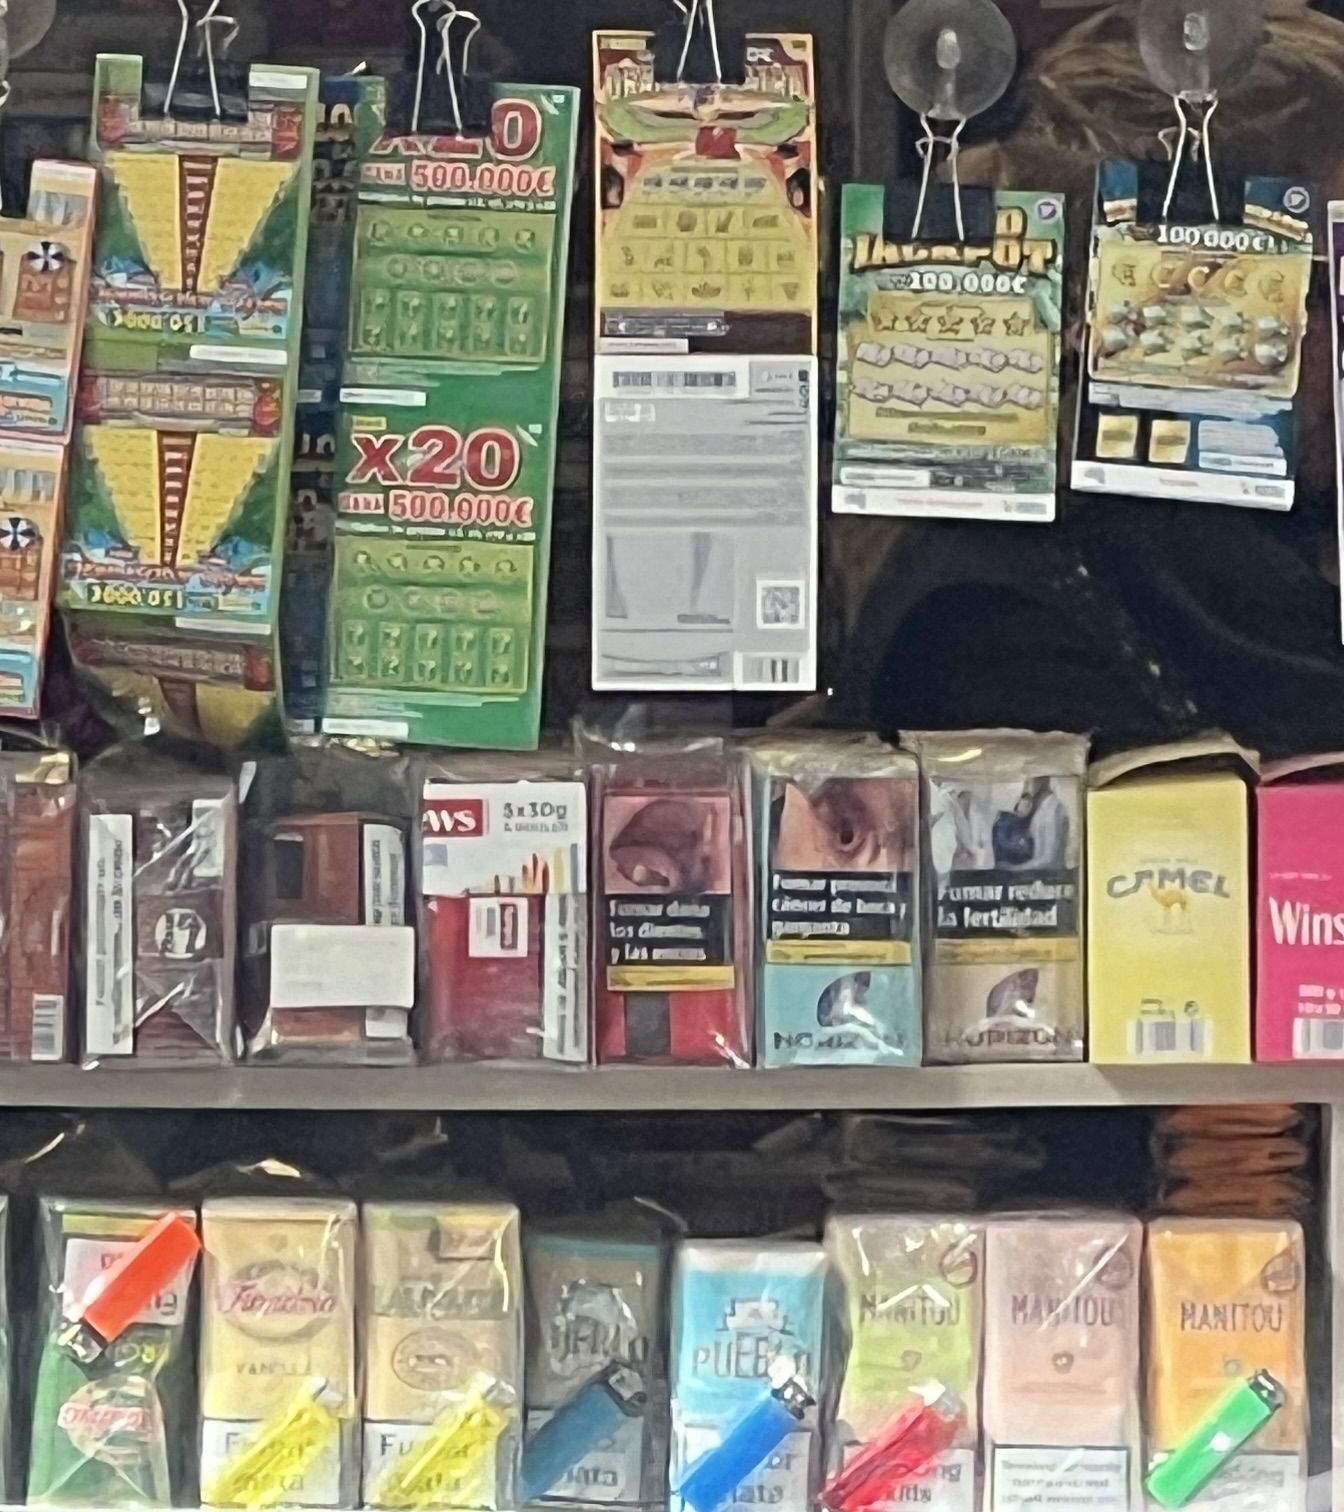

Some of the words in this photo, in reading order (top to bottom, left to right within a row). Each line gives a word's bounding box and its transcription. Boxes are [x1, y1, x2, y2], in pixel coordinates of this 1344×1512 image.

[345, 424, 522, 492] x20
[1106, 866, 1231, 899] CAMEL
[1180, 1301, 1284, 1333] MANITOU
